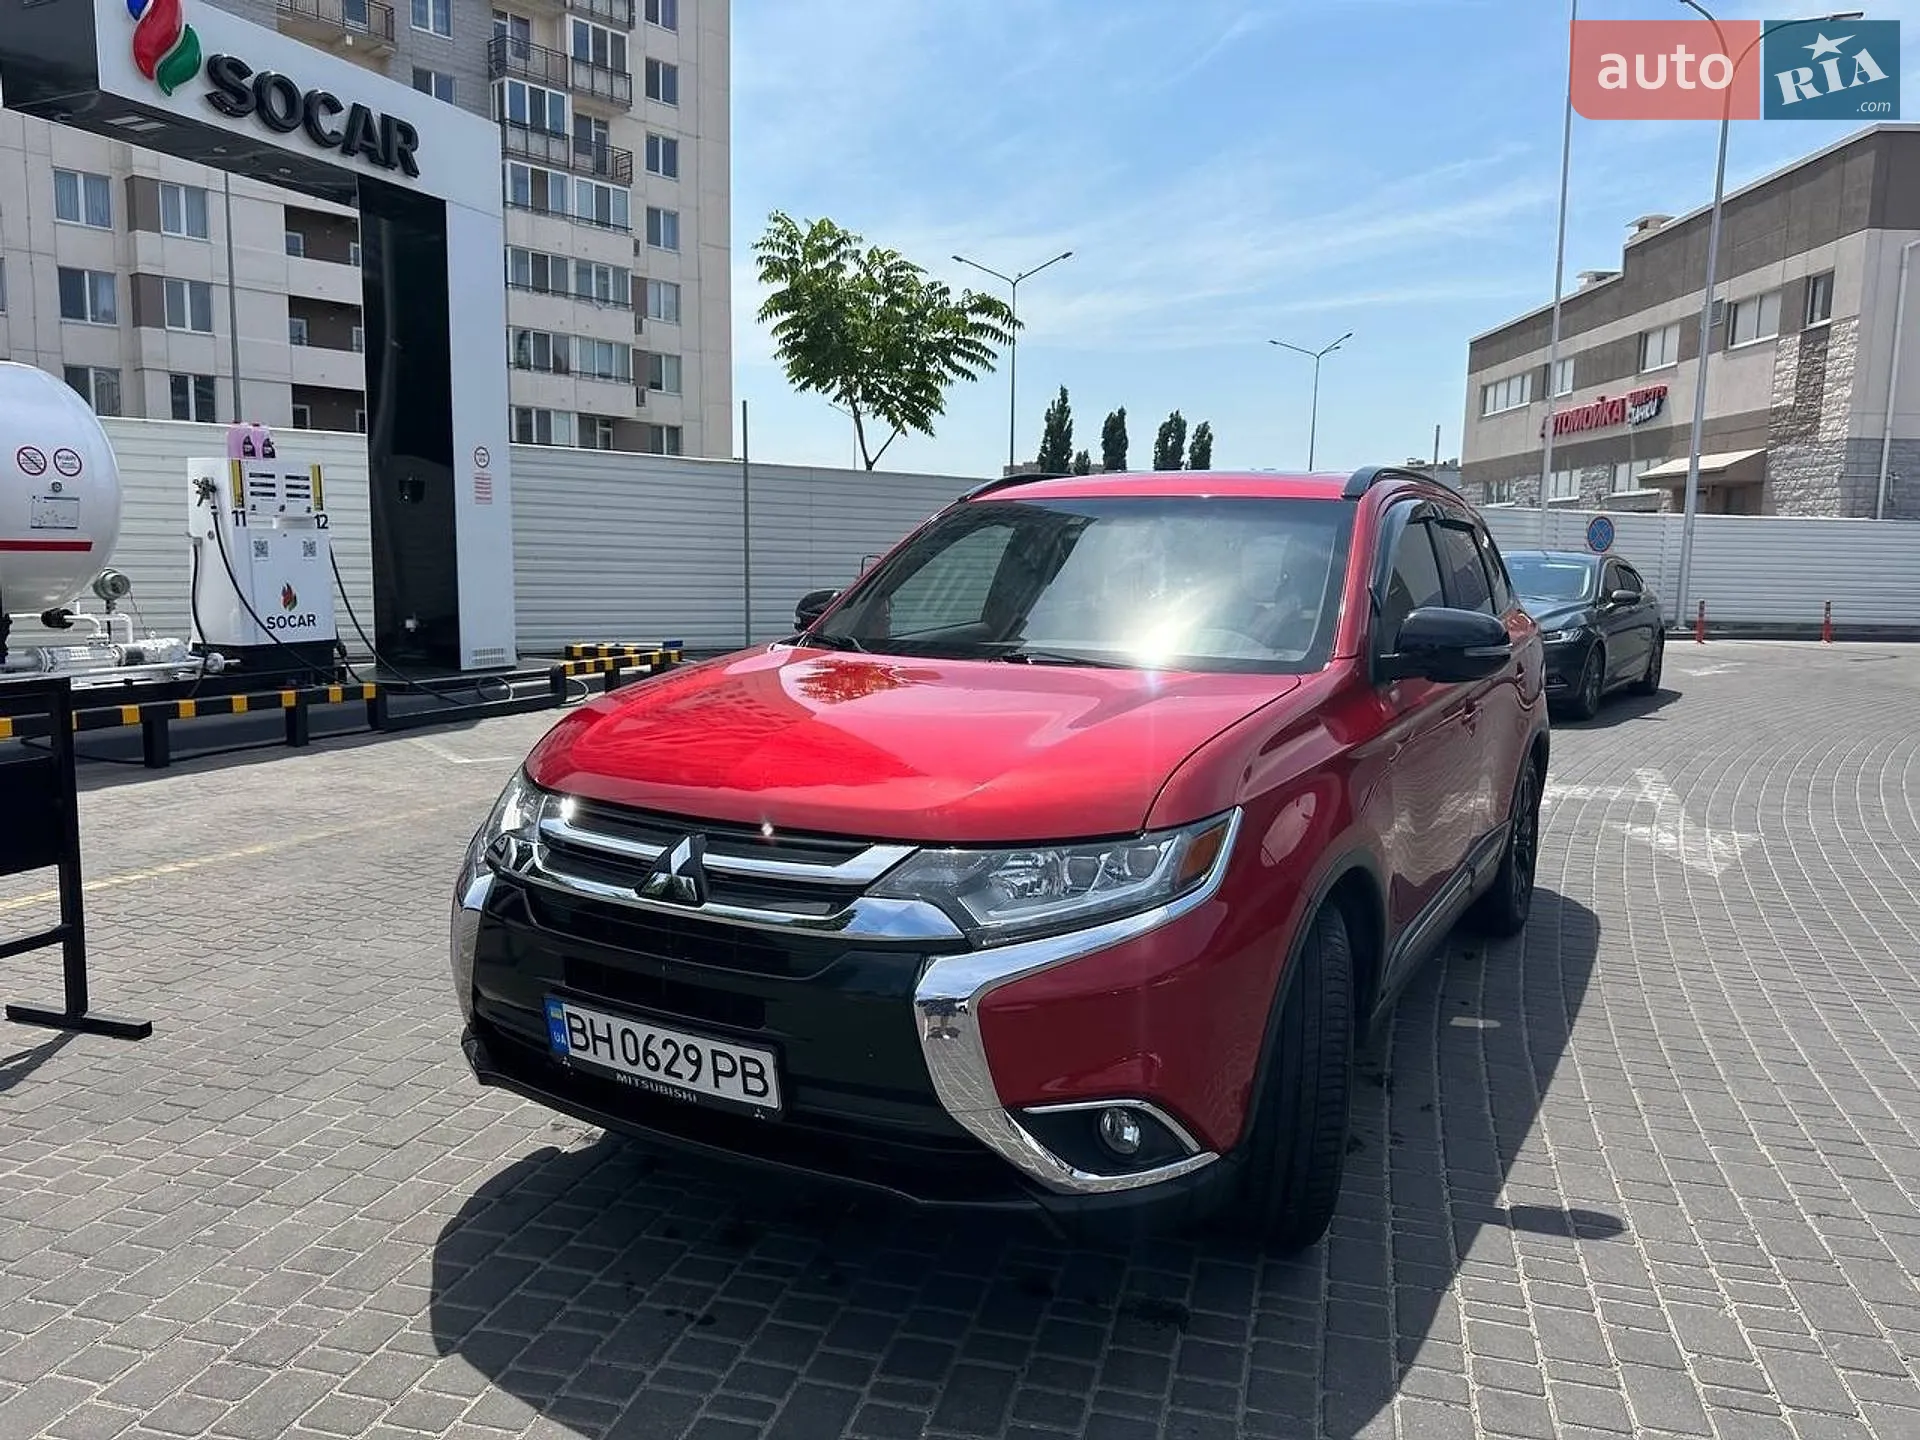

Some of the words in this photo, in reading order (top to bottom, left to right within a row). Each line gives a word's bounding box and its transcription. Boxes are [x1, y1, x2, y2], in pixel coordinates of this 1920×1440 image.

[204, 54, 420, 178] SOCAR
[1540, 396, 1627, 438] ТОМОЙКА
[231, 510, 247, 527] 11
[314, 514, 329, 529] 12
[266, 614, 316, 630] SOCAR
[554, 1032, 566, 1045] UA
[616, 1072, 698, 1103] MITSUBISHI
